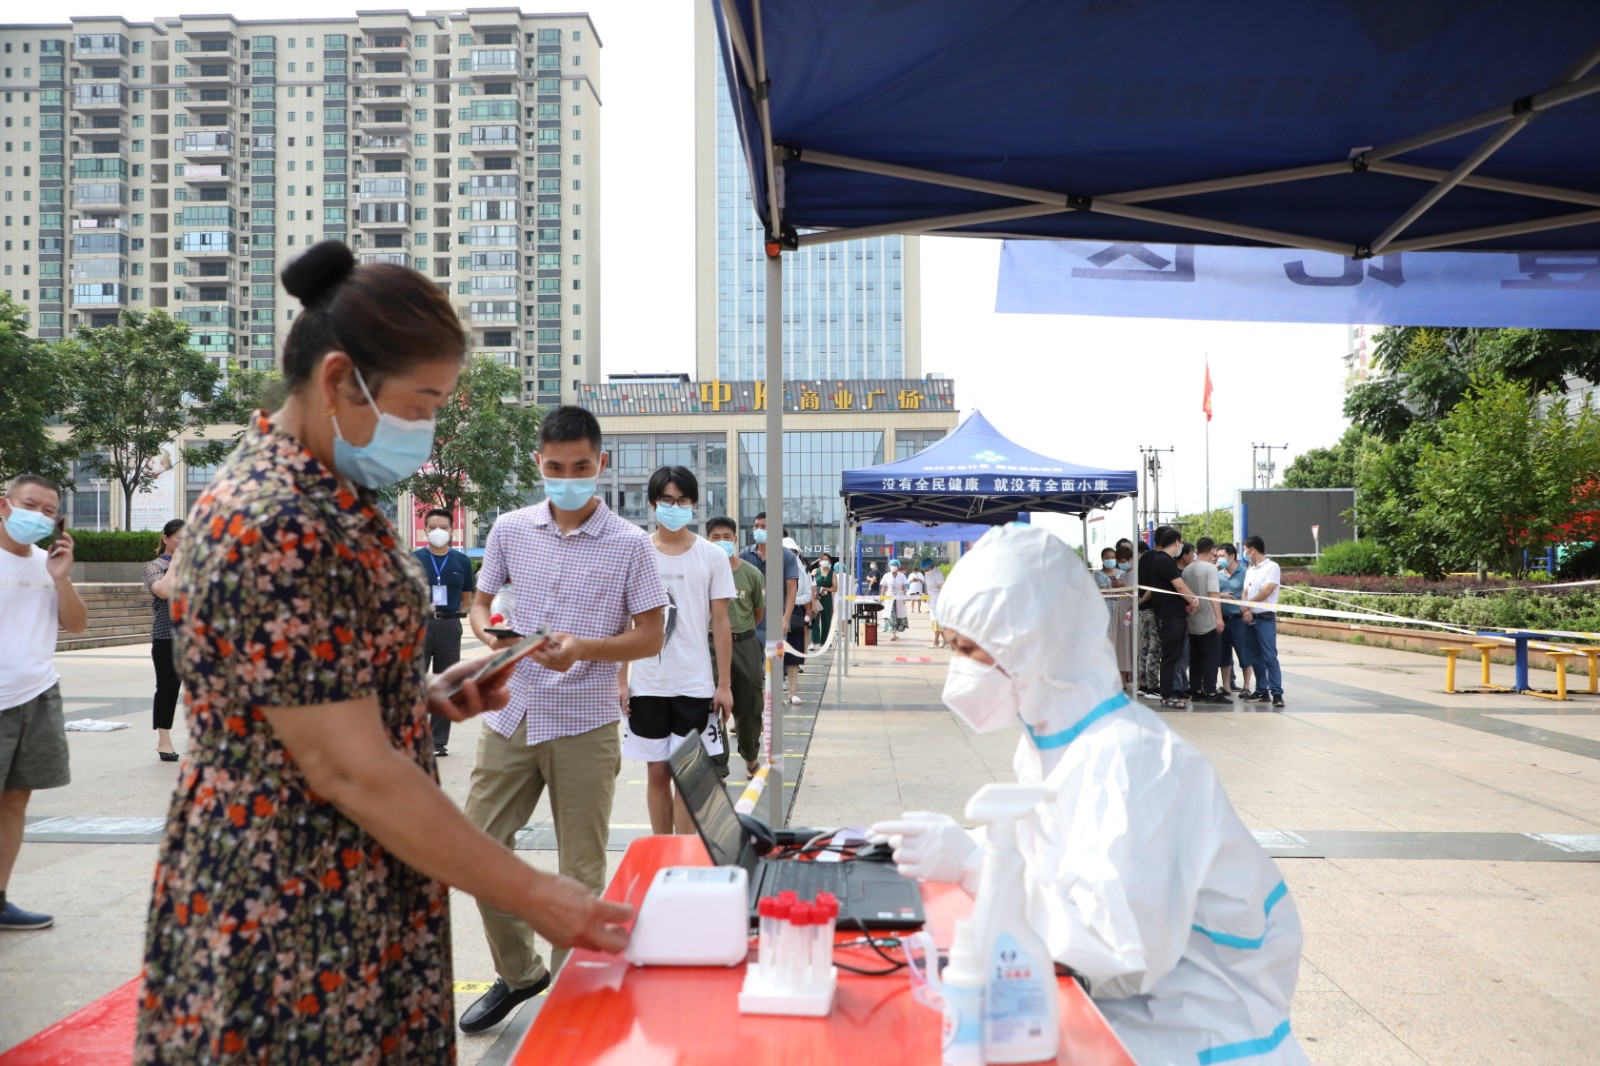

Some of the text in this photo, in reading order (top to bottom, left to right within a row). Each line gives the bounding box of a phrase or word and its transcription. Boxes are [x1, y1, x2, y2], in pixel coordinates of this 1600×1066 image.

[882, 477, 1109, 492] 没有全民健康 就没有全面小康
